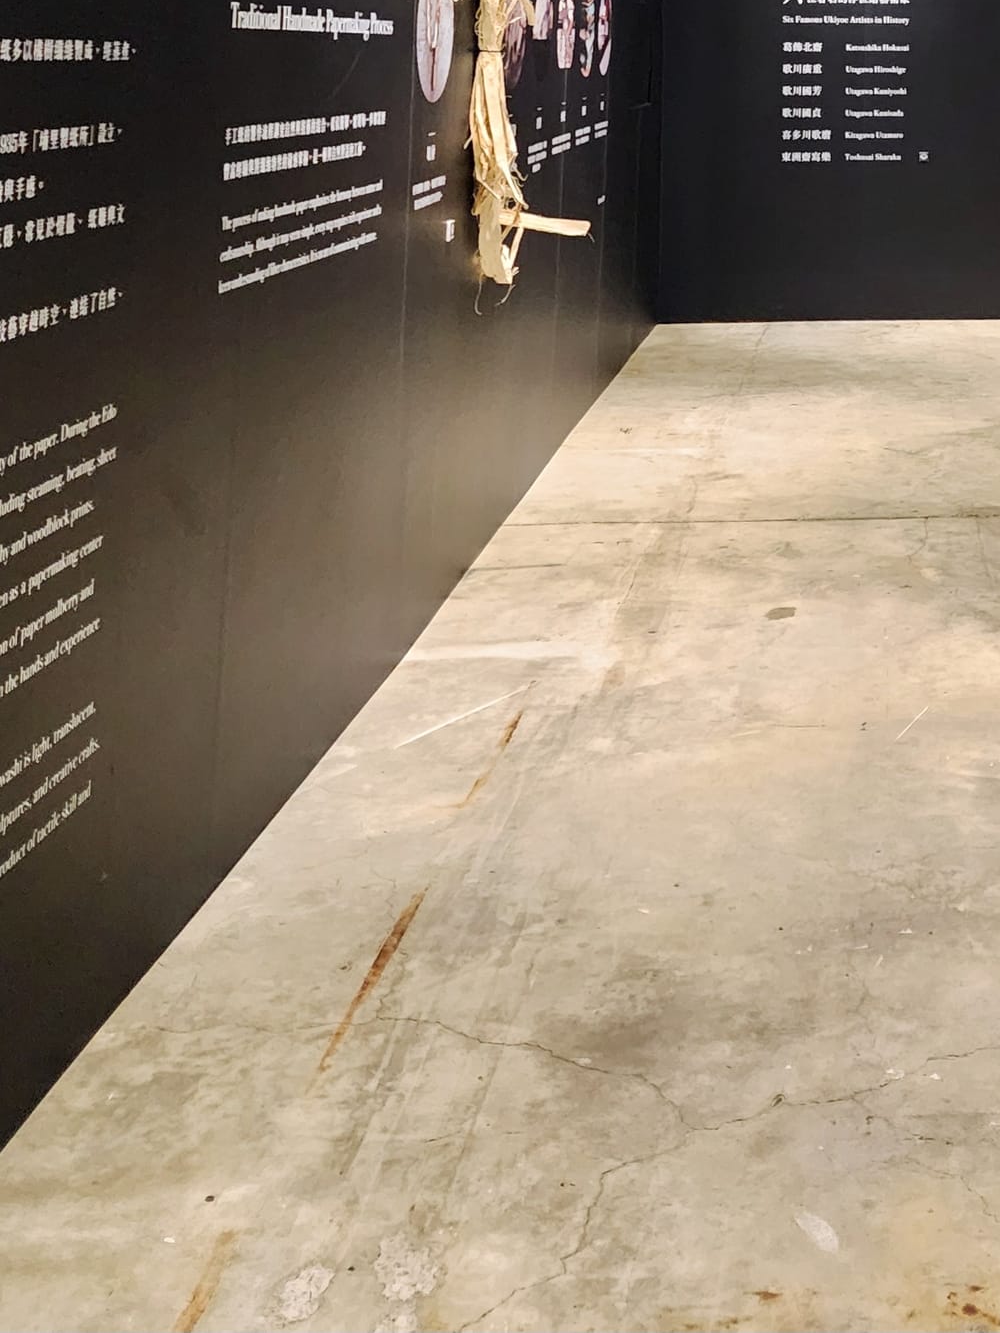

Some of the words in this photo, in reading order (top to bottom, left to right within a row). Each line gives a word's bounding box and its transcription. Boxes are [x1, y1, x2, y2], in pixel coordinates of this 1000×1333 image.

[883, 16, 909, 25] History
[34, 434, 59, 459] paper.
[61, 419, 89, 442] During
[10, 531, 27, 555] and
[27, 509, 69, 545] woodblock
[28, 550, 80, 595] papermaking
[21, 616, 44, 647] paper
[45, 593, 79, 624] mulberry
[20, 655, 43, 683] hands
[60, 618, 100, 654] experience
